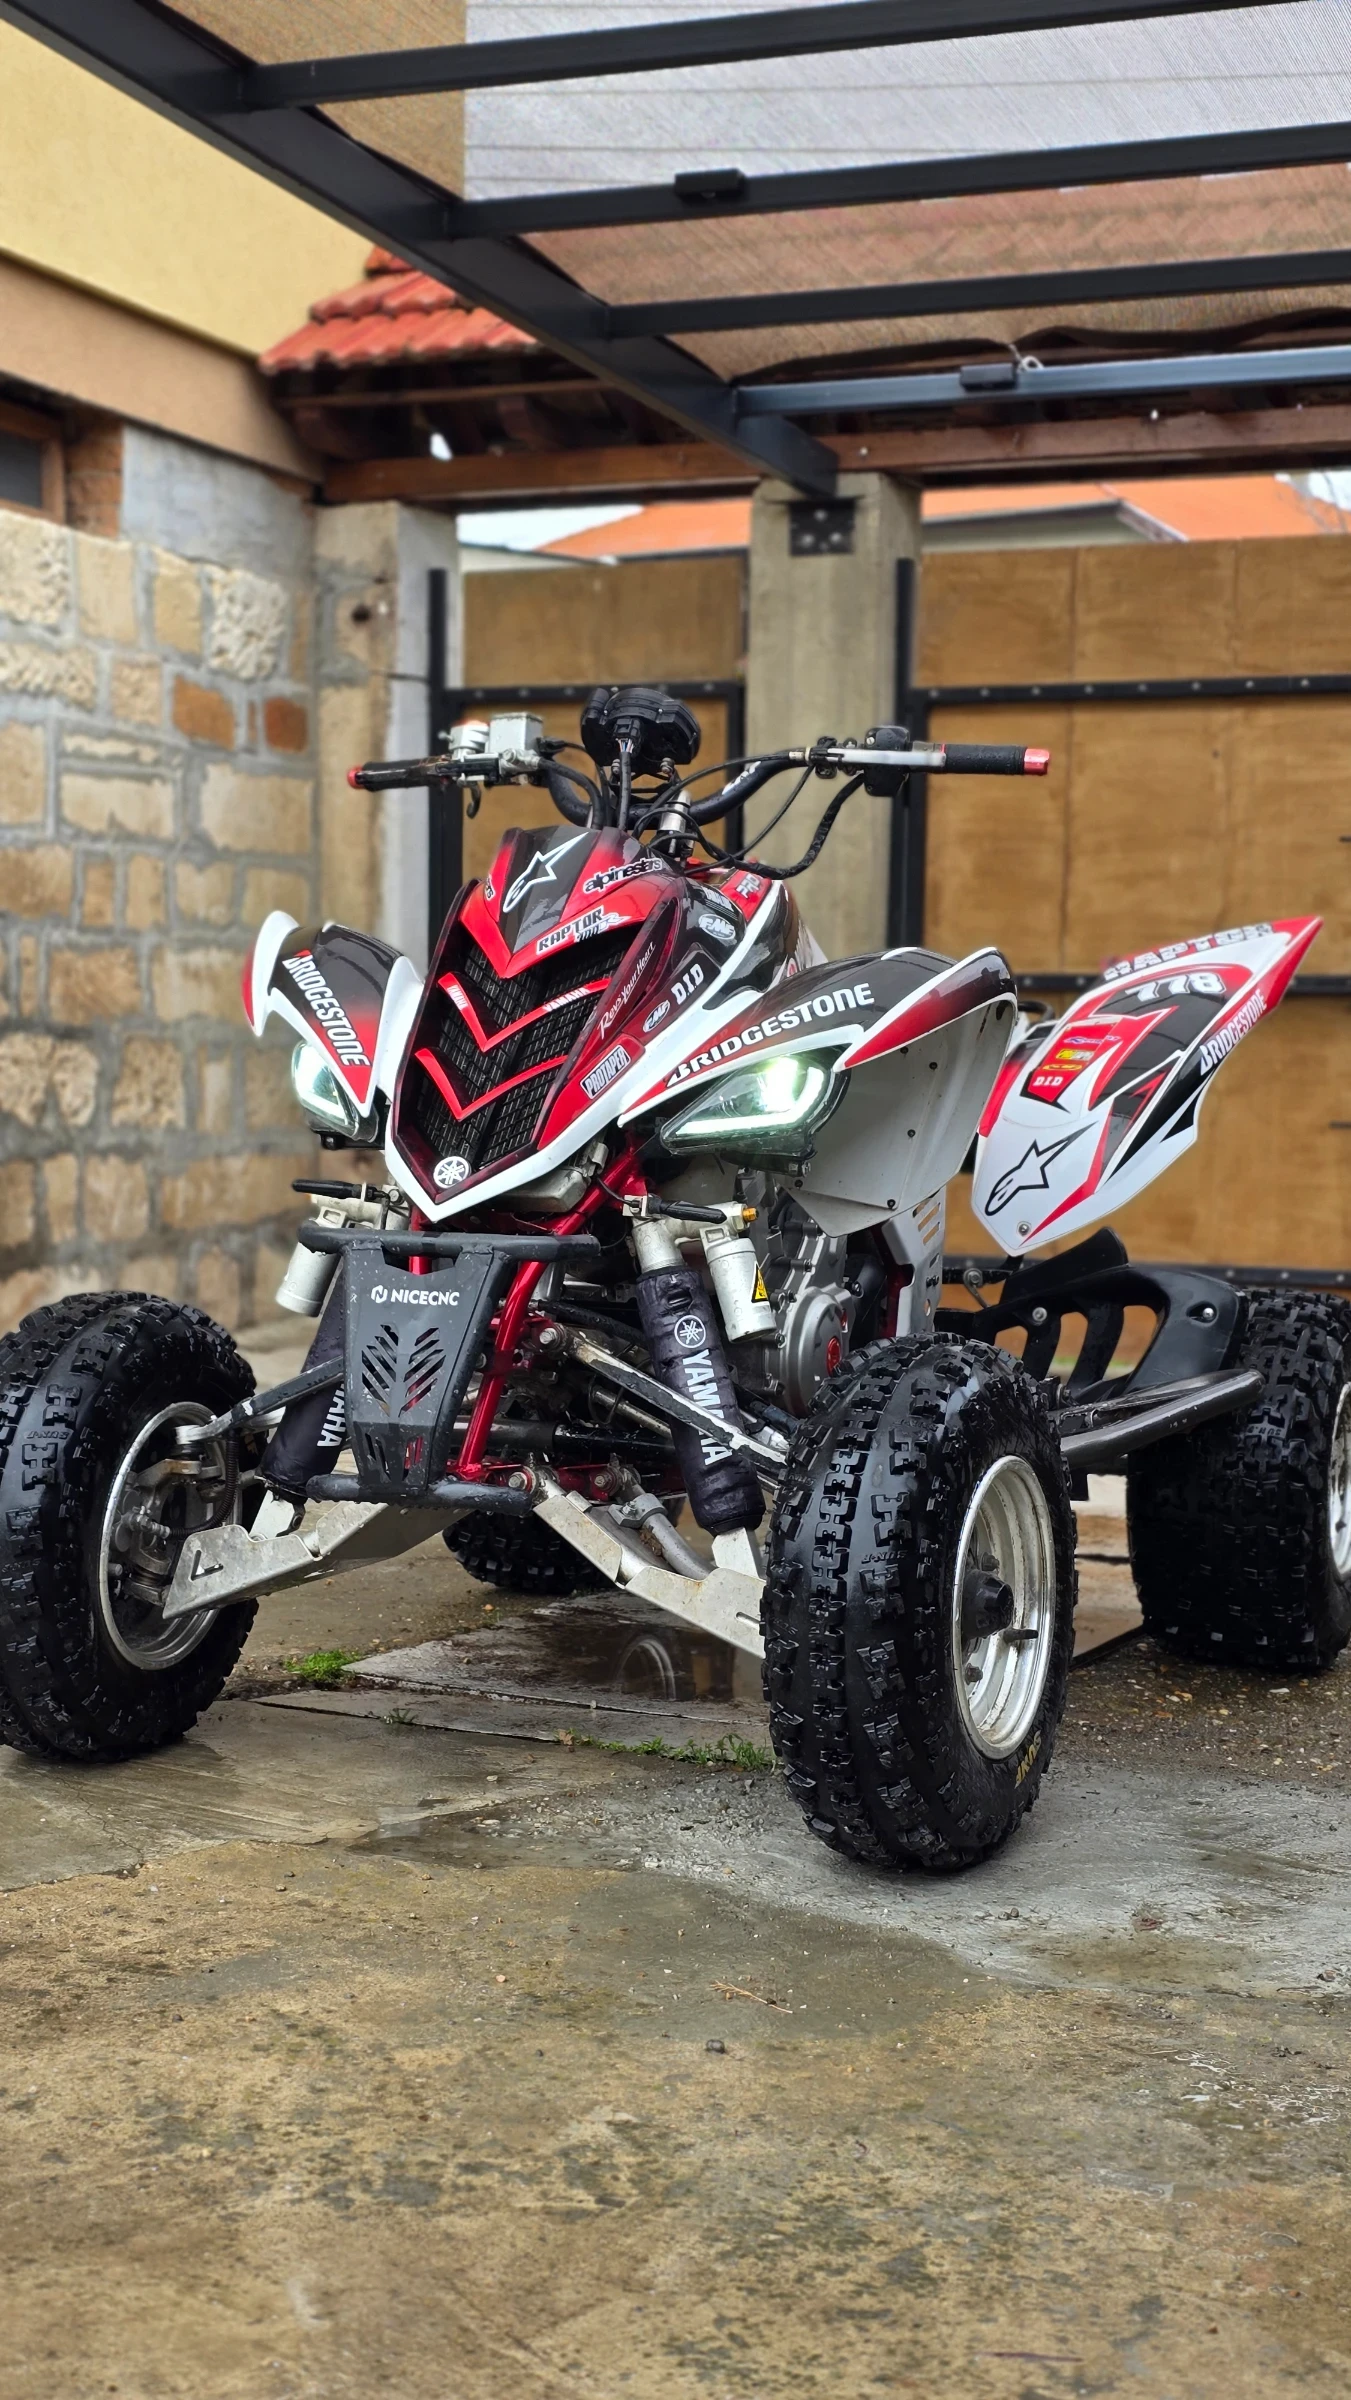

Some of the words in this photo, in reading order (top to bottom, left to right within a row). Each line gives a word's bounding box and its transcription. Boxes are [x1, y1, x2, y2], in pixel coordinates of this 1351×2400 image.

[584, 858, 663, 895] alpinestars
[537, 905, 604, 953] RAPTOR
[282, 953, 371, 1067] BRIDGESTONE
[542, 987, 591, 1013] YAMAHA
[665, 983, 875, 1088] BRIDGESTONE
[1200, 988, 1267, 1076] BRIDGESTONE
[583, 1046, 630, 1097] PROTAPER
[390, 1289, 460, 1306] NICECNC
[682, 1348, 733, 1466] YAMA
